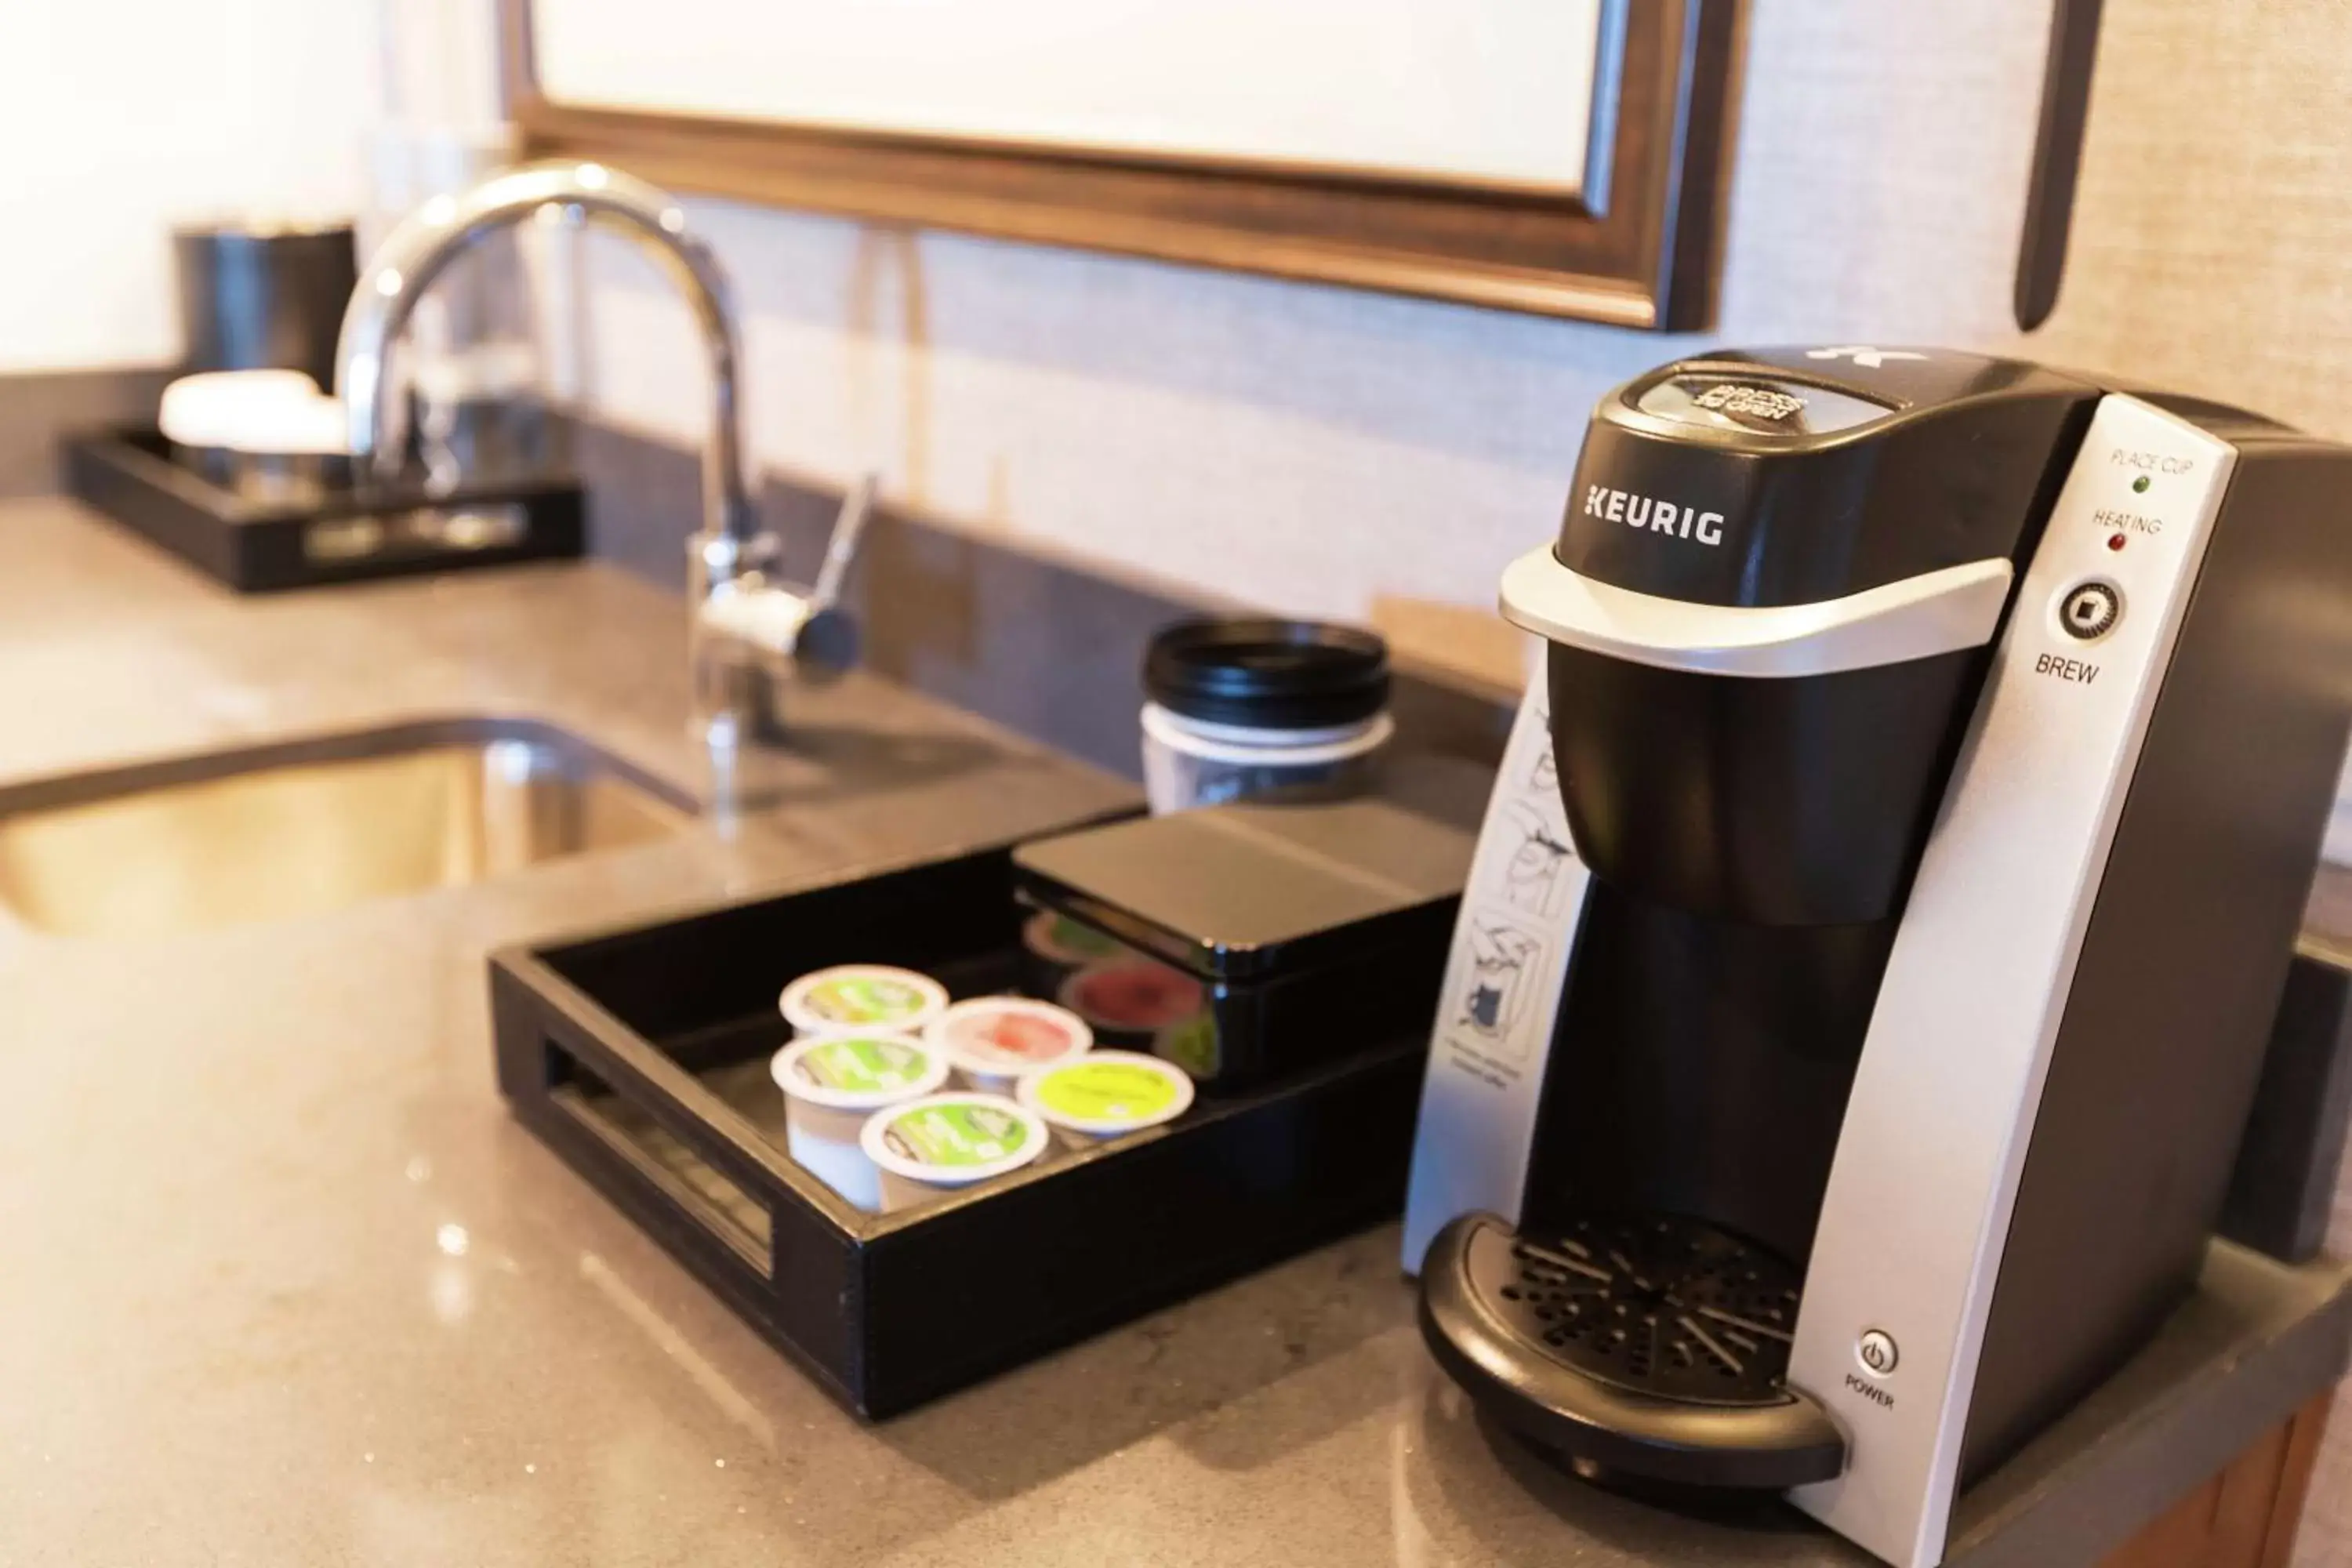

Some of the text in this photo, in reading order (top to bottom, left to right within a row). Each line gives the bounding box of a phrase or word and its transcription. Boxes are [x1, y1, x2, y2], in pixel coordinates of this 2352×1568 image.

[1726, 400, 1789, 420] OPEN
[2111, 448, 2194, 475] PLACE CUP
[1584, 485, 1725, 546] KEURIG
[2092, 509, 2163, 535] HEATING
[2035, 653, 2100, 685] BREW
[1845, 1374, 1894, 1412] POWER
